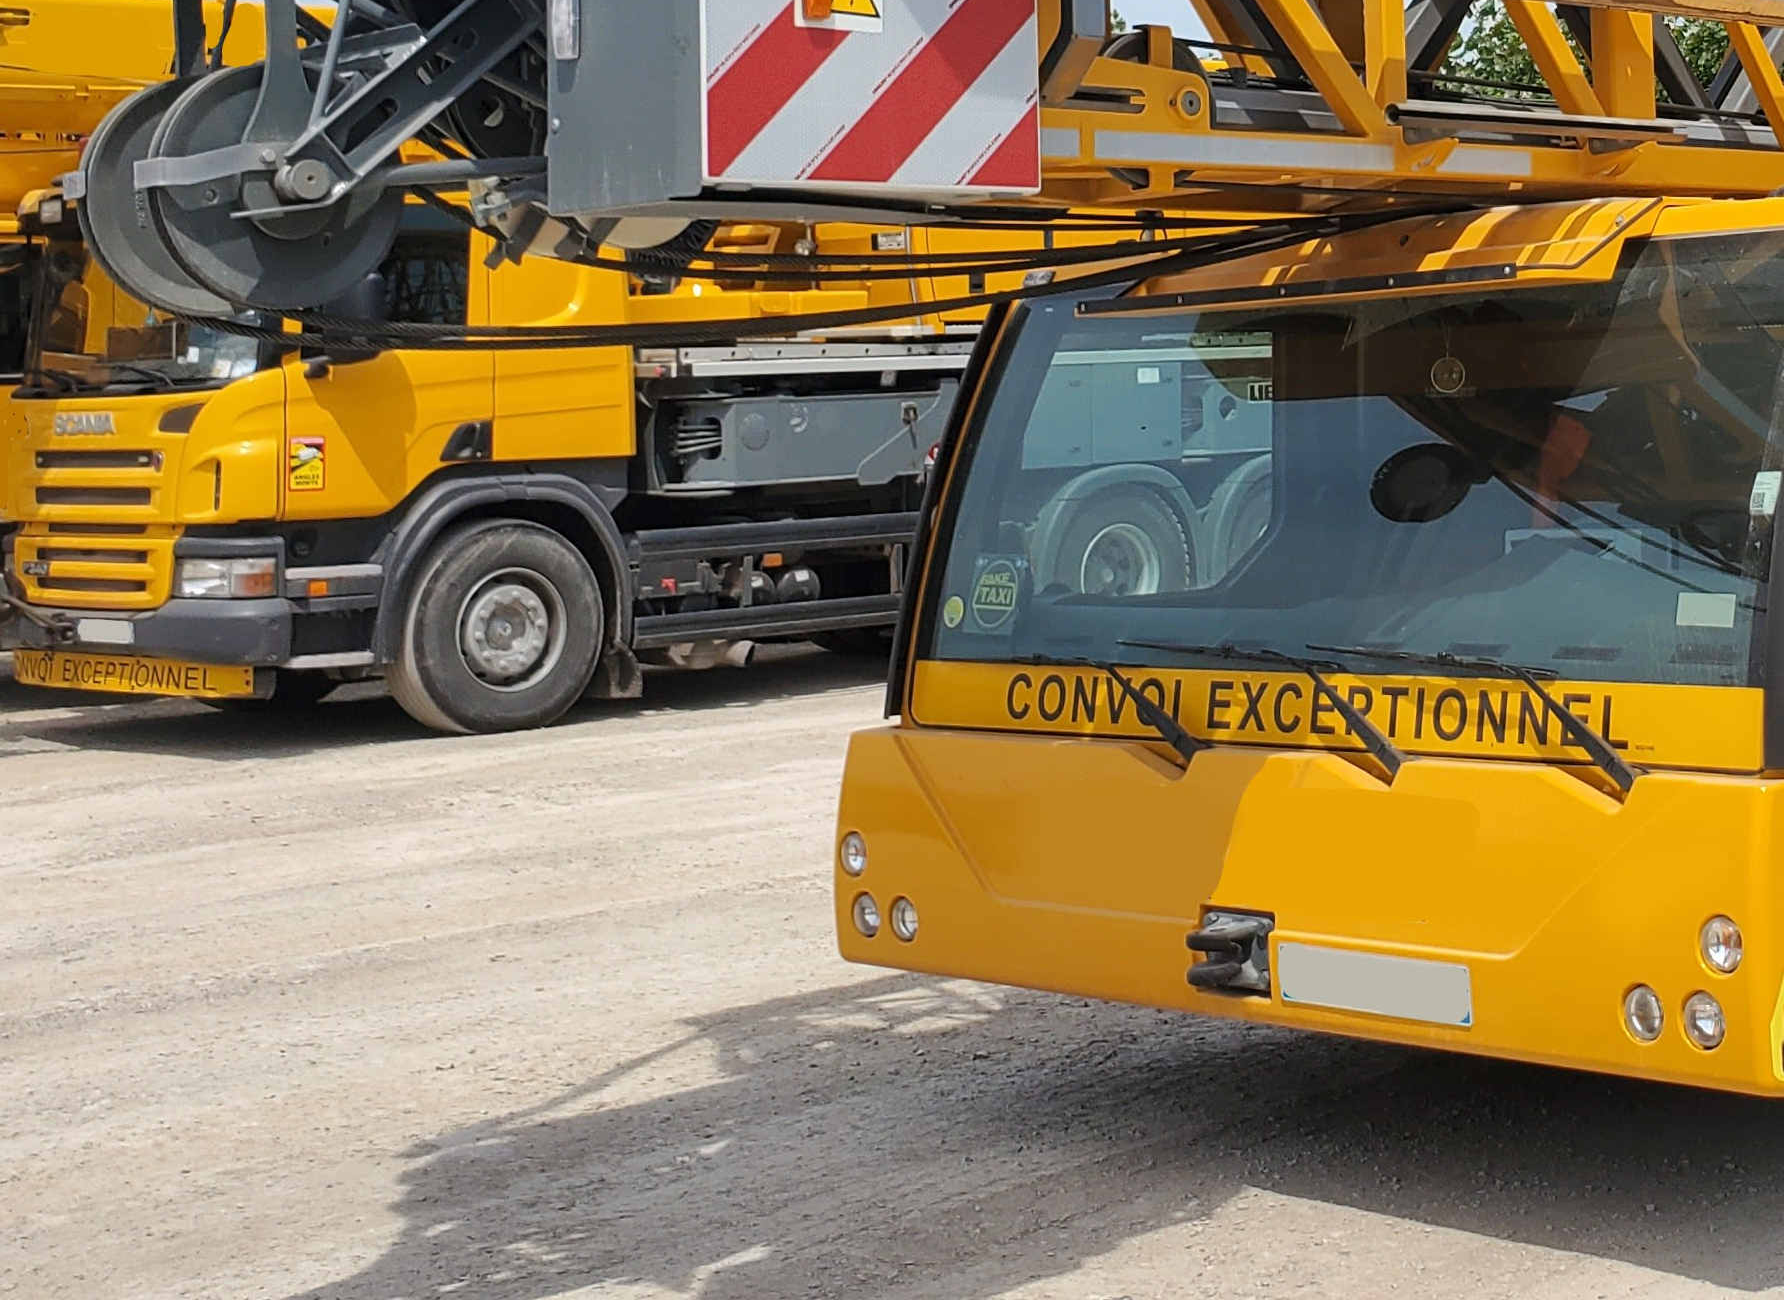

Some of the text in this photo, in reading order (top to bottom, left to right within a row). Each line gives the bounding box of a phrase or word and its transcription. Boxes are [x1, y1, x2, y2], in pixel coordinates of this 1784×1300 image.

[55, 412, 116, 436] SCANIA
[980, 586, 1013, 605] TAXI
[62, 659, 218, 691] EXCEPTIONNEL
[1006, 673, 1630, 750] CONVOI EXCEPTIONNEL
